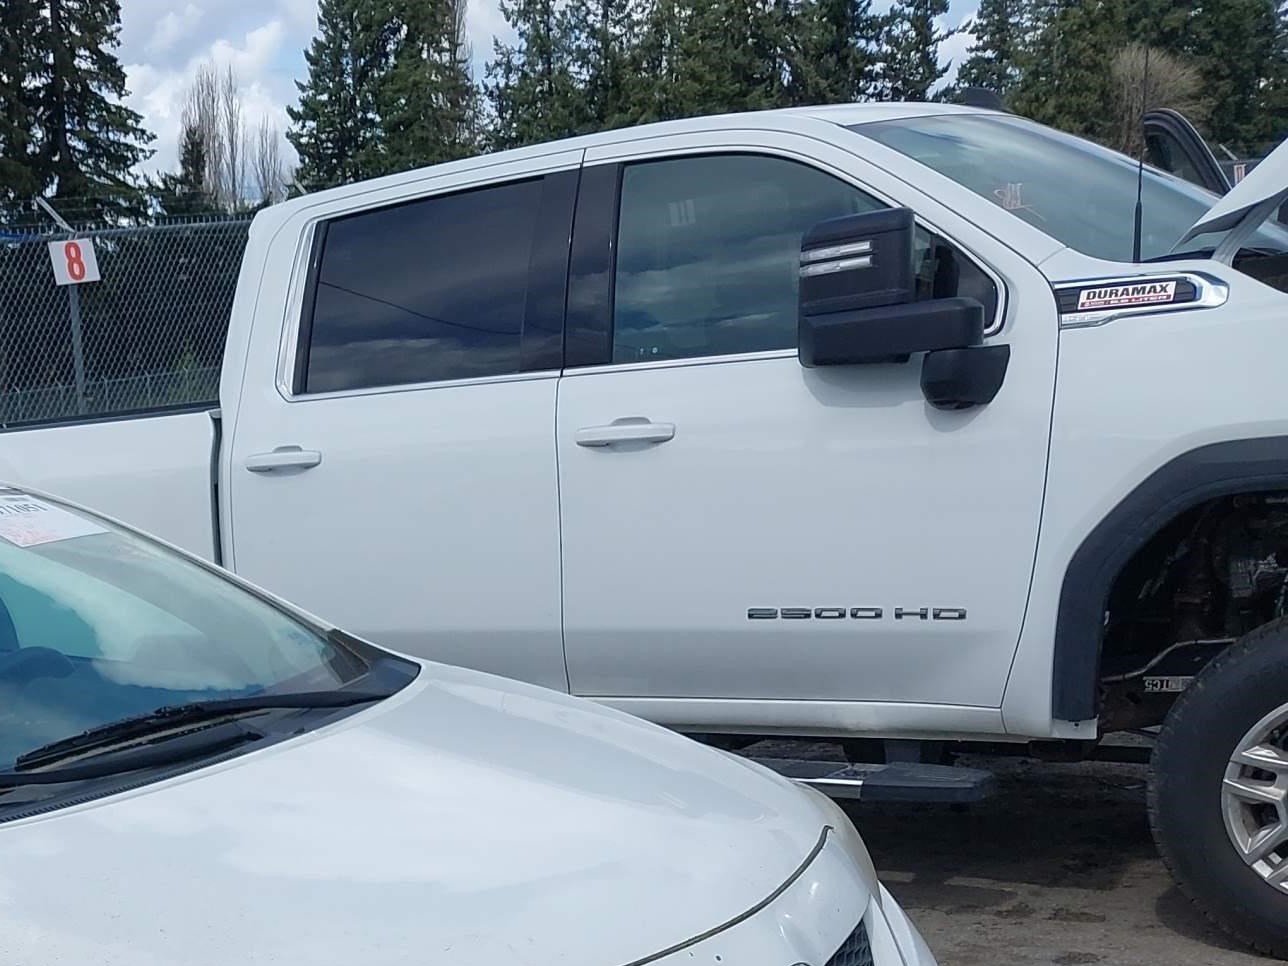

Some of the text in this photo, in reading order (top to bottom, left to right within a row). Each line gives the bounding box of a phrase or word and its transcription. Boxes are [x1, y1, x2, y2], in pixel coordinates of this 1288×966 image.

[64, 241, 86, 281] 8
[1085, 283, 1170, 301] DURAMAX
[747, 606, 968, 621] 2500 HD
